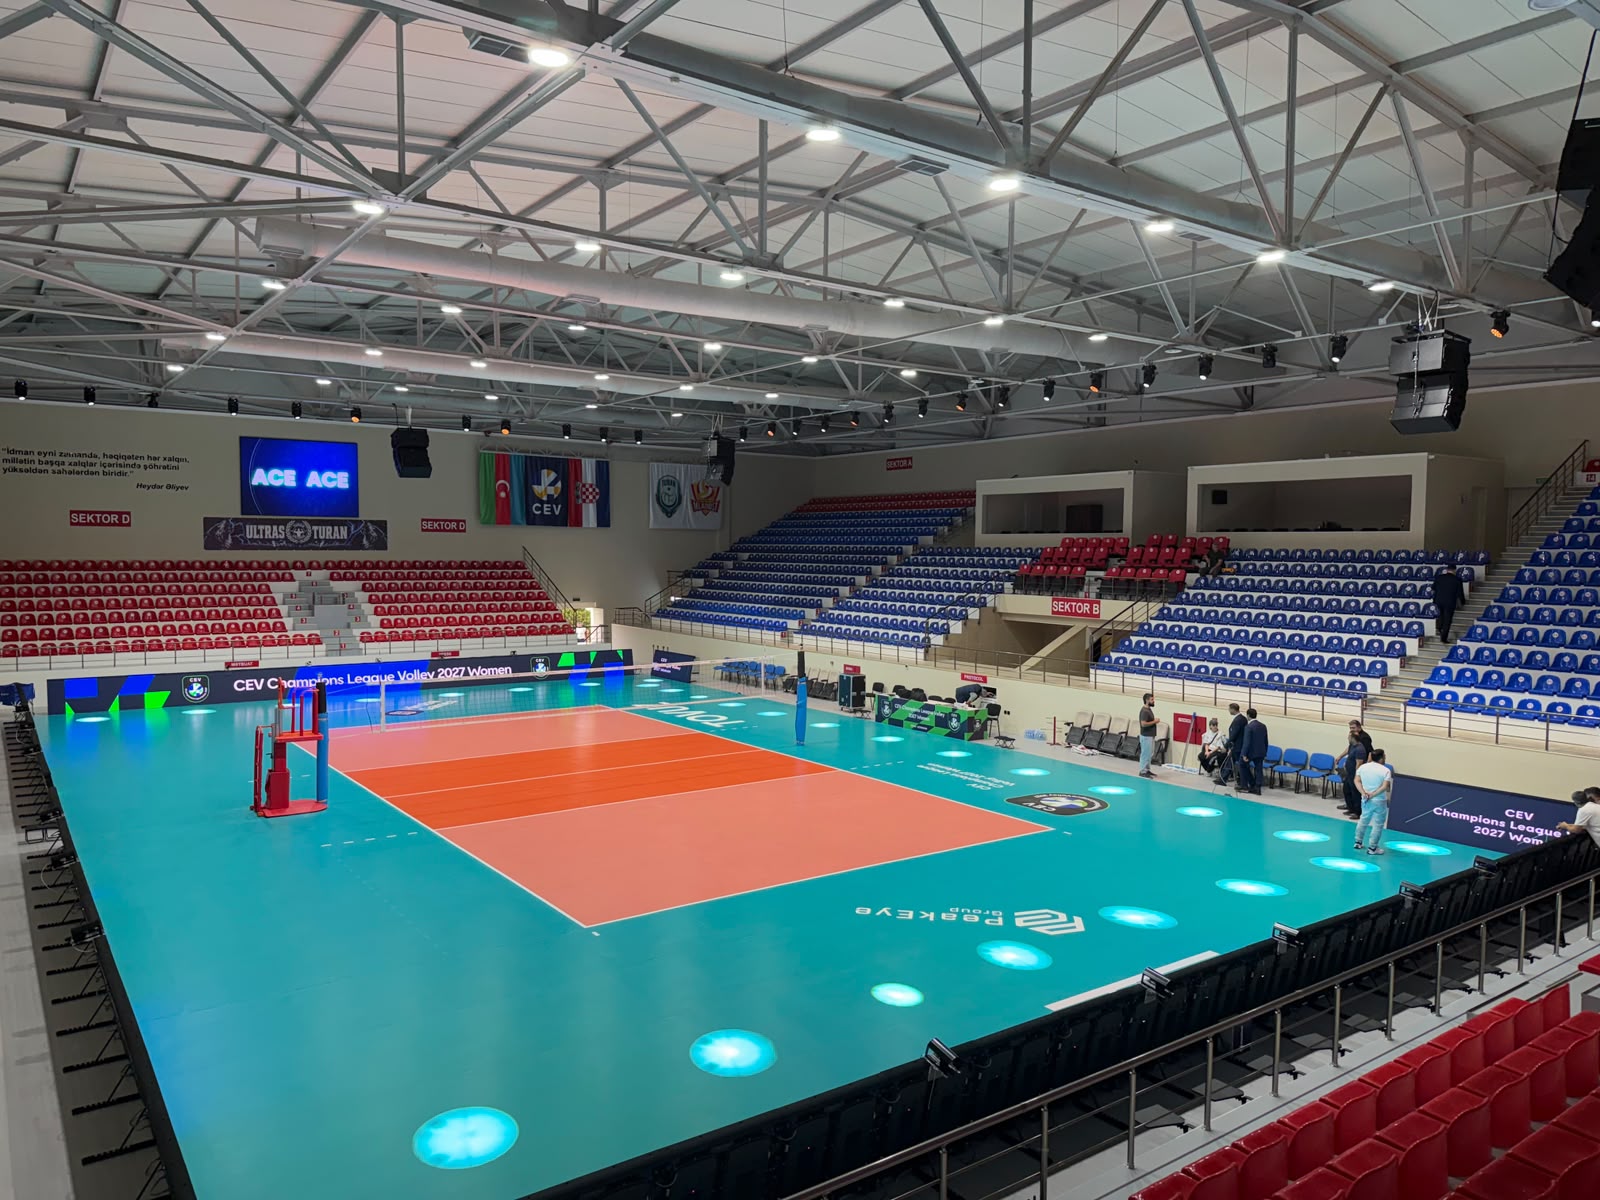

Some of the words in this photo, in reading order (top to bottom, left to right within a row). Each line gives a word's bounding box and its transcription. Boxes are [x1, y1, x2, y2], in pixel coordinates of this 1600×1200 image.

[887, 460, 907, 469] SEKTOR
[252, 468, 297, 487] ACE
[306, 471, 349, 489] ACE
[532, 503, 562, 515] CEV
[71, 513, 119, 523] SEKTOR
[122, 514, 130, 524] D
[421, 520, 457, 530] SEKTOR
[459, 522, 466, 530] D
[245, 525, 286, 539] ULTRAS
[312, 525, 348, 540] TURAN
[1052, 601, 1090, 614] SEKTOR
[1093, 603, 1099, 614] B
[233, 678, 264, 691] CEV
[347, 671, 394, 684] League
[437, 667, 465, 678] 2027
[466, 665, 512, 676] Women
[1022, 802, 1057, 812] CEV
[1505, 809, 1534, 821] CEV
[1433, 807, 1506, 827] Champions
[1509, 821, 1562, 838] League
[1473, 825, 1506, 839] 2027
[1508, 832, 1544, 846] Wom
[855, 907, 1004, 926] PeakEye
[949, 907, 1003, 917] Group
